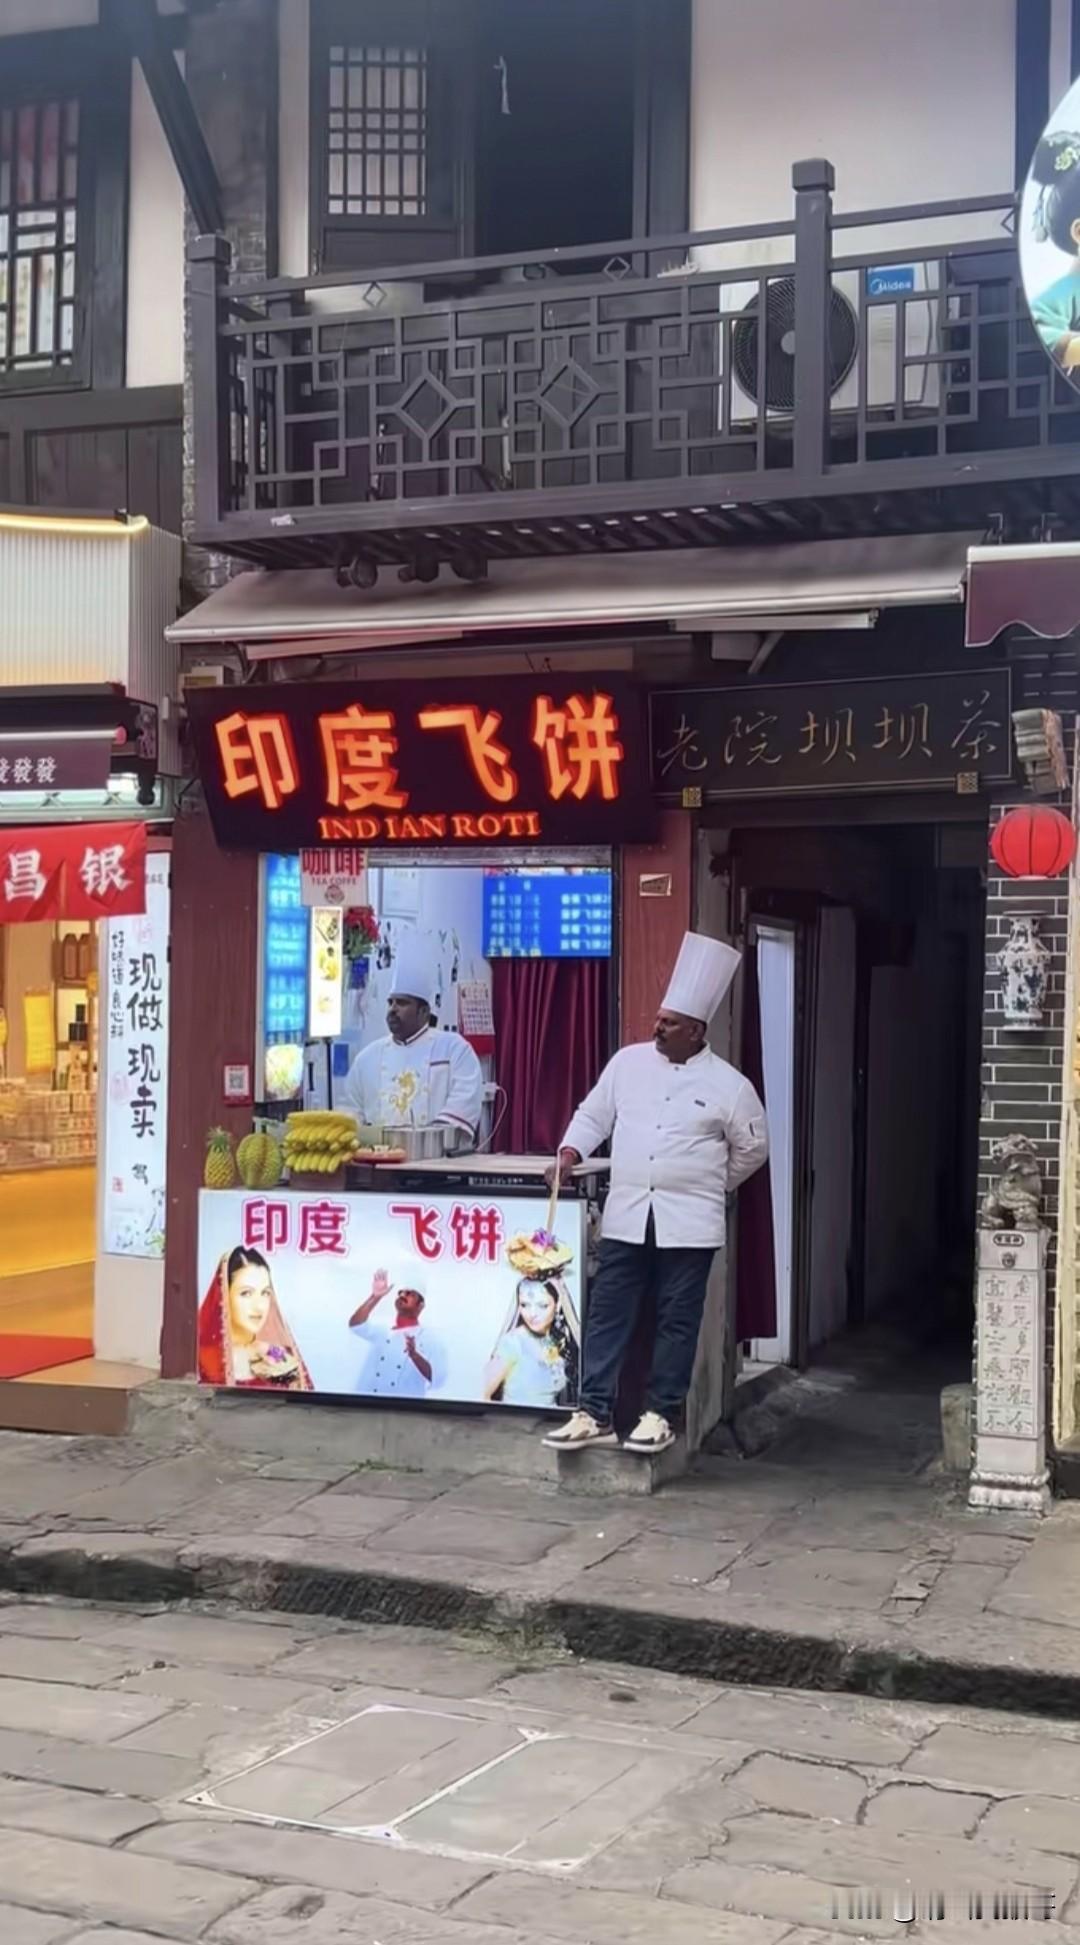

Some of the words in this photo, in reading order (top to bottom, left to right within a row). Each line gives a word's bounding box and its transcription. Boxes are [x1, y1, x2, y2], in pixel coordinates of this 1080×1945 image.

[874, 279, 912, 292] Midea
[214, 694, 624, 810] 印度飞饼
[656, 690, 1001, 776] 老院坝坝茶
[451, 811, 541, 838] ROTI
[302, 849, 366, 876] 咖啡
[126, 952, 164, 1139] 现做现卖
[242, 1198, 348, 1256] 印度
[389, 1202, 503, 1262] 飞饼
